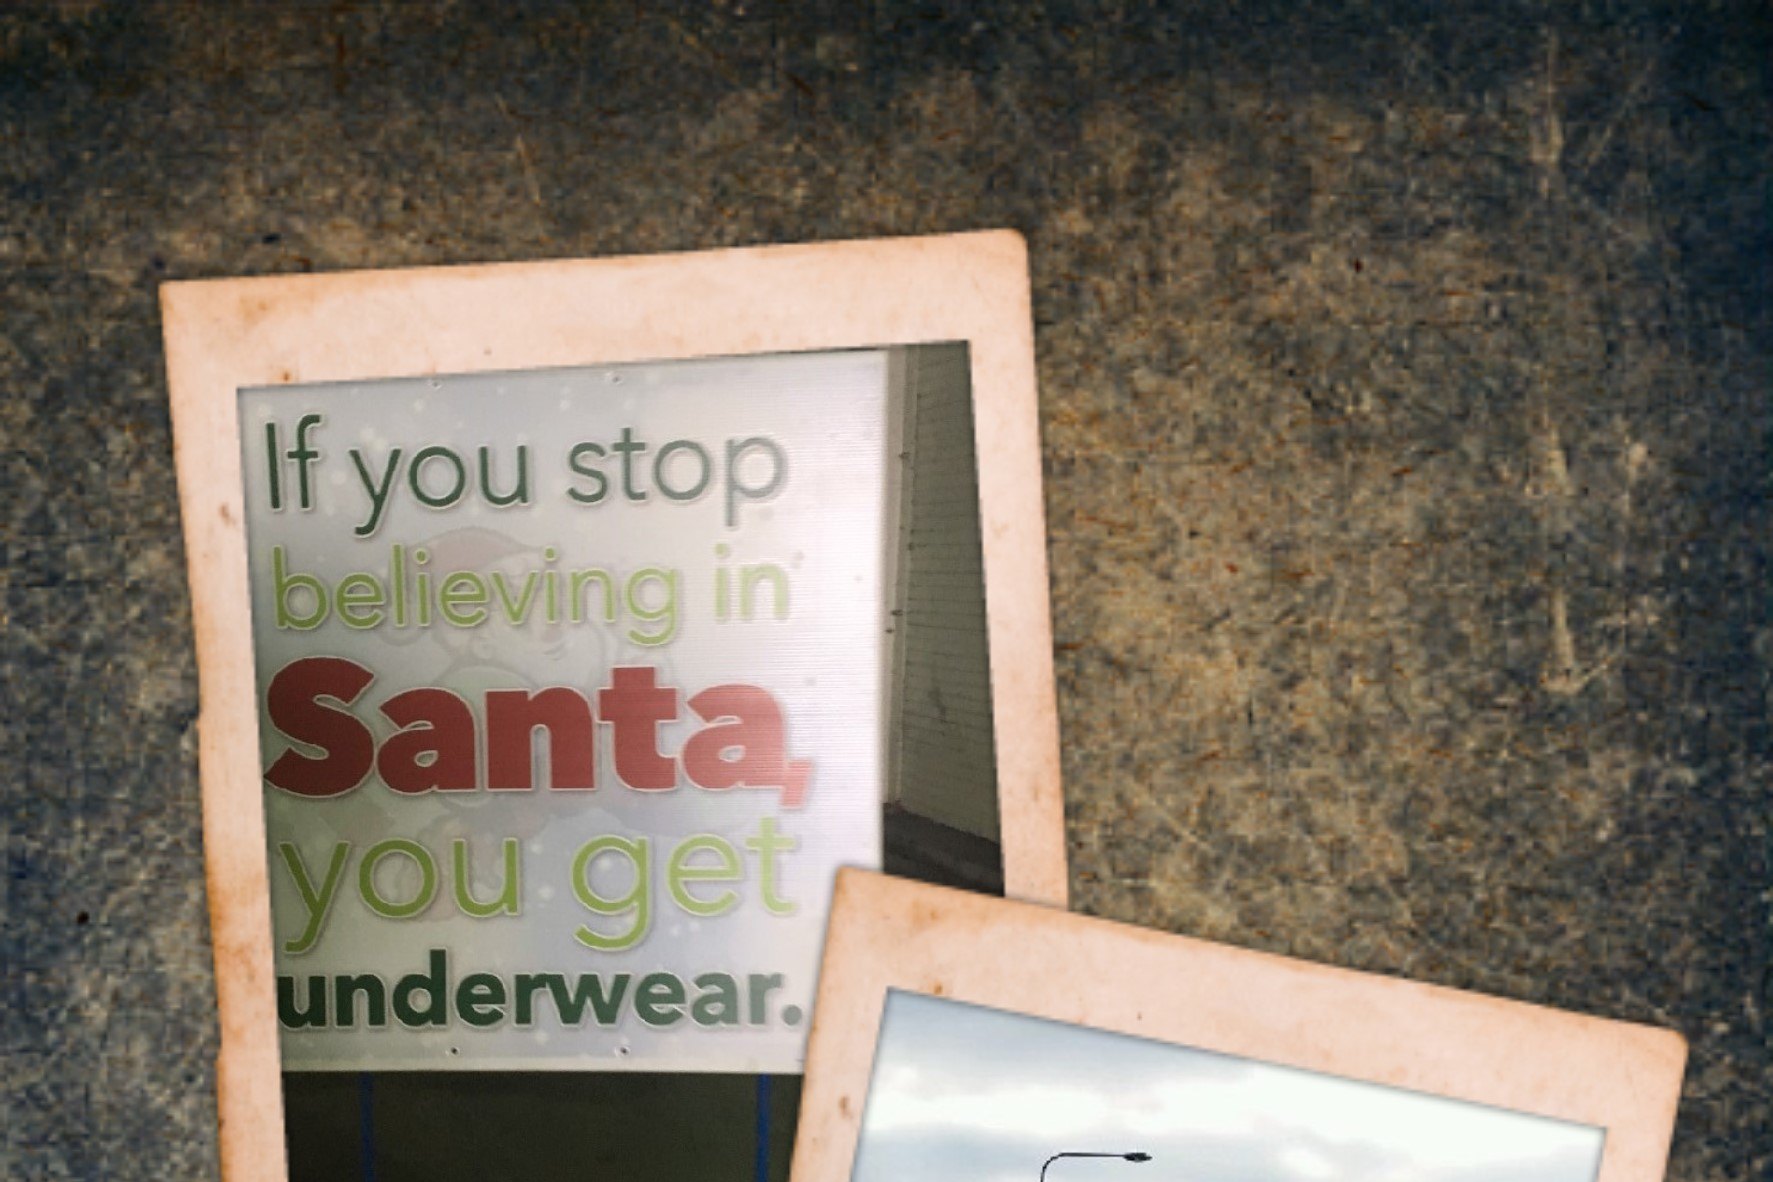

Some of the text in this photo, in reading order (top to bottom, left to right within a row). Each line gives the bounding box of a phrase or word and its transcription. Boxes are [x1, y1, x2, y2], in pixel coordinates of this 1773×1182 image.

[265, 414, 788, 537] If you stop
[273, 543, 789, 646] believing in
[263, 657, 814, 808] Santa,
[281, 817, 797, 953] you get
[277, 949, 803, 1030] underwear.
